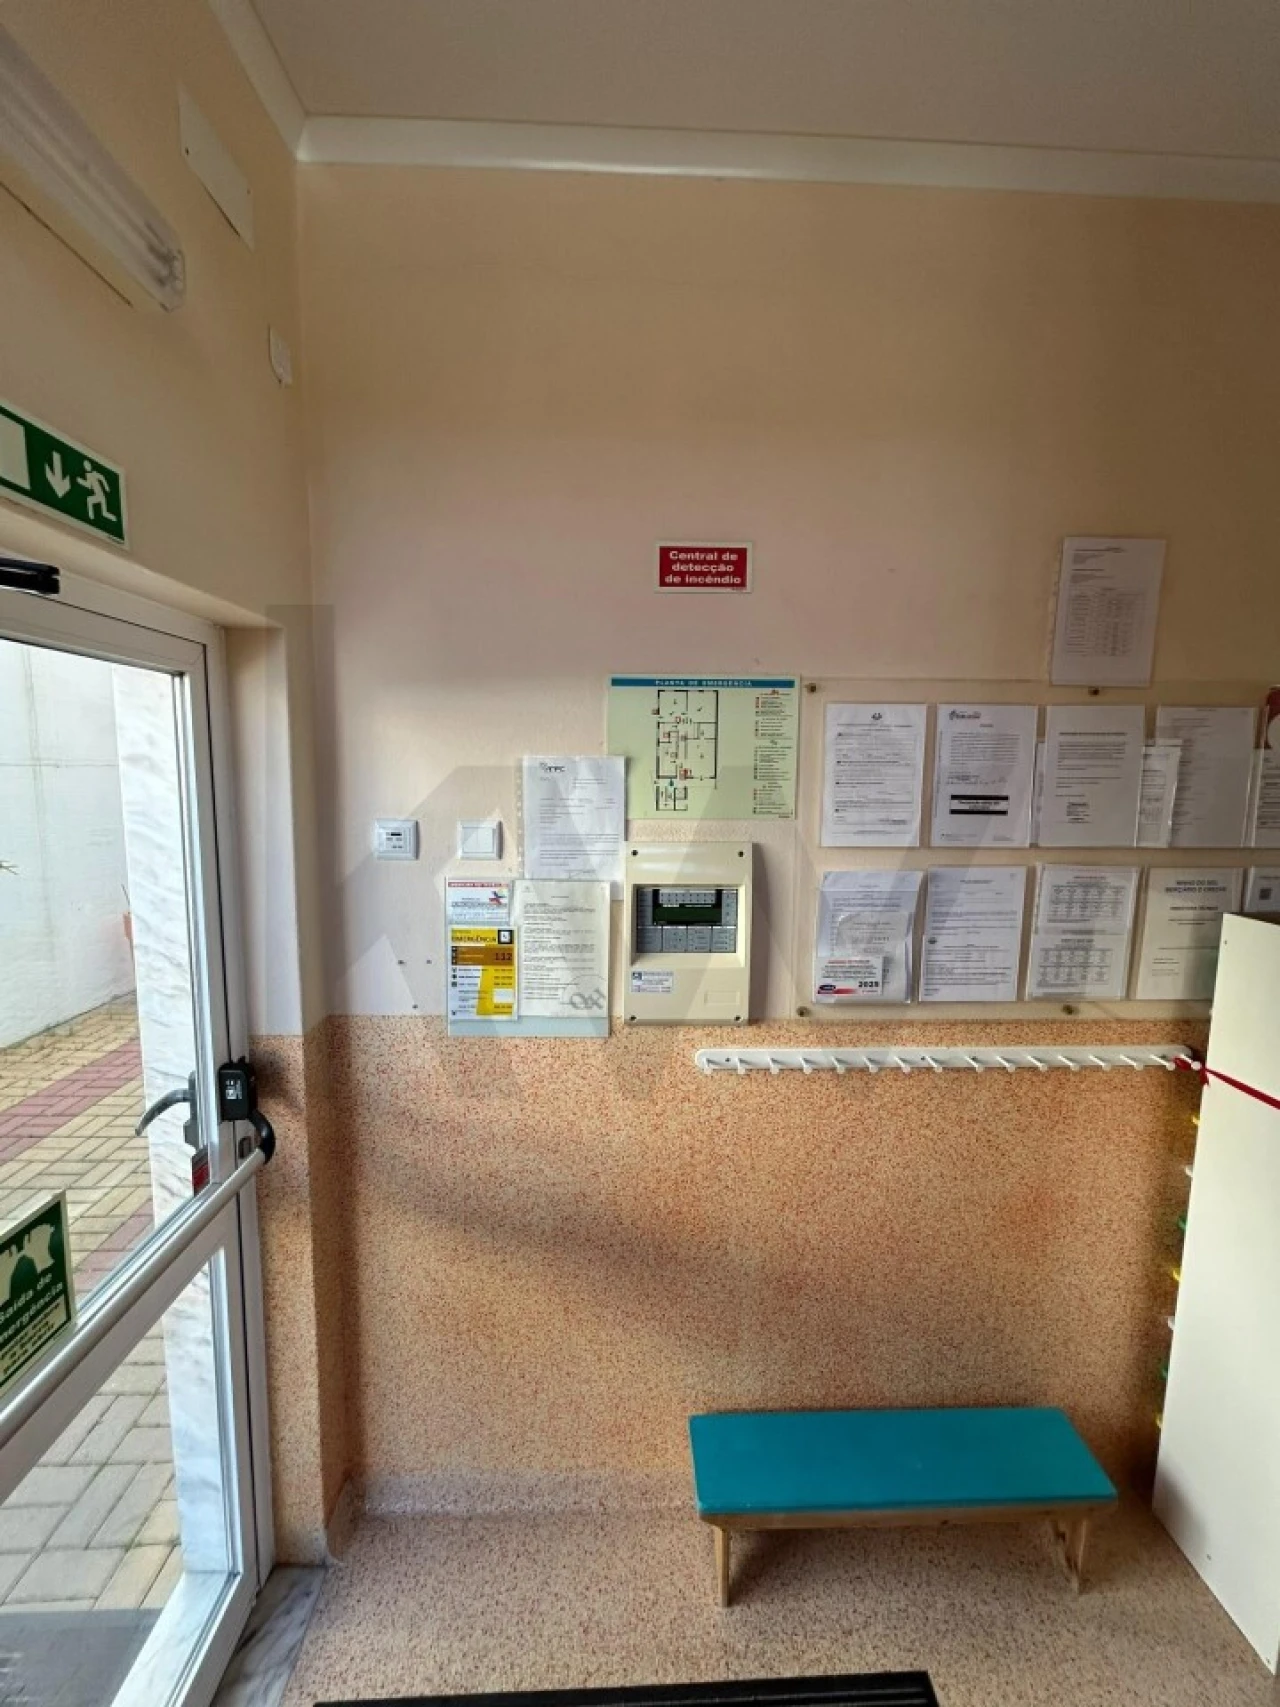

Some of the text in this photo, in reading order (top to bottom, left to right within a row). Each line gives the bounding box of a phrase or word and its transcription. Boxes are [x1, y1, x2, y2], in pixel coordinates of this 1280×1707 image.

[669, 550, 738, 561] Central de
[671, 562, 734, 573] detecção
[664, 574, 742, 584] de incêndio
[495, 952, 513, 961] 112
[0, 1282, 63, 1344] mergência
